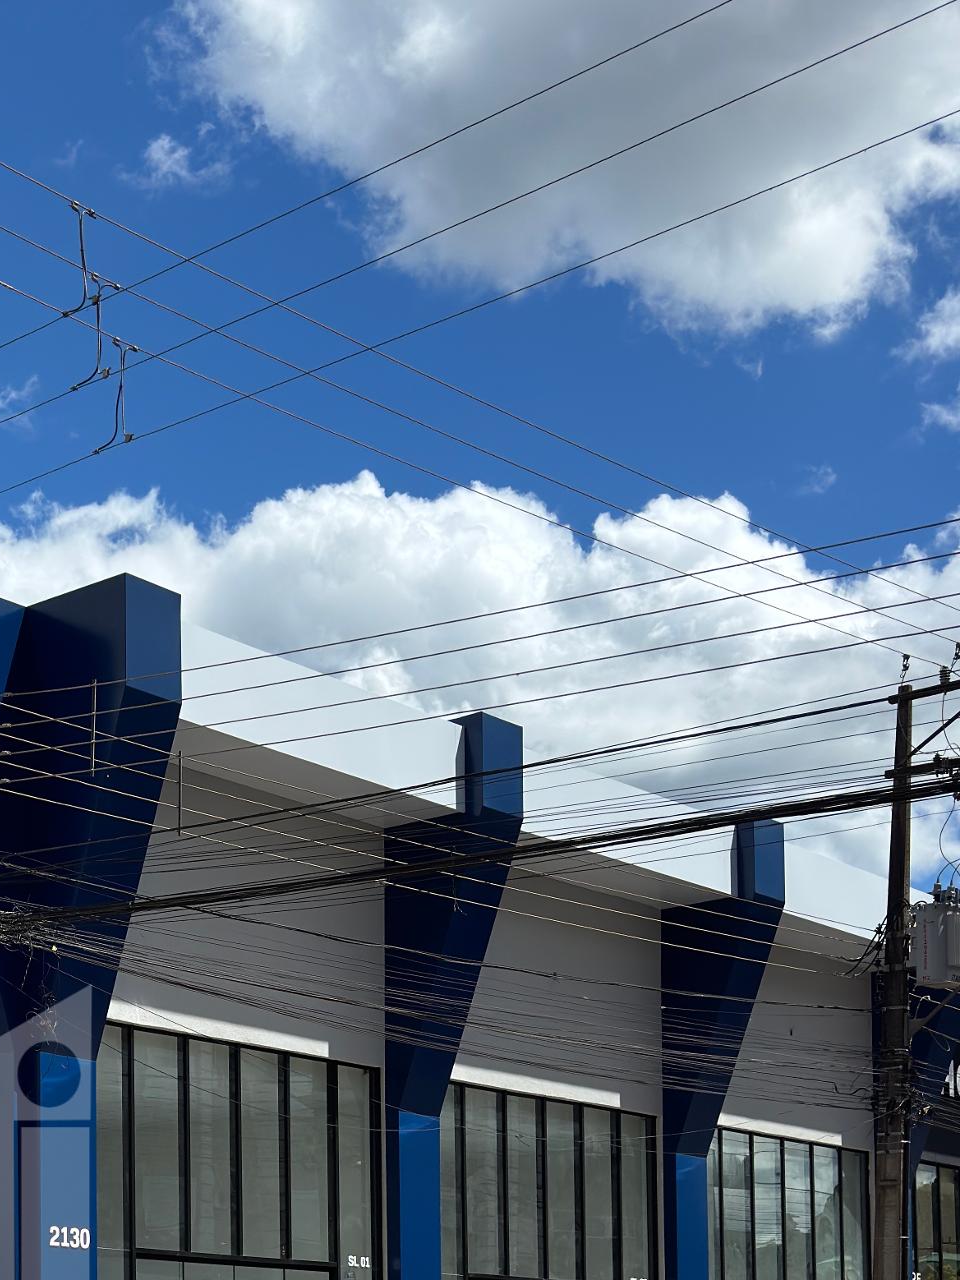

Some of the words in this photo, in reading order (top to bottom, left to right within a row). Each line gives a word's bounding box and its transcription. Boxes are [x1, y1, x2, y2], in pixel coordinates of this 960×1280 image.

[49, 1225, 91, 1249] 2130
[348, 1255, 360, 1267] SL
[360, 1256, 370, 1268] 01
